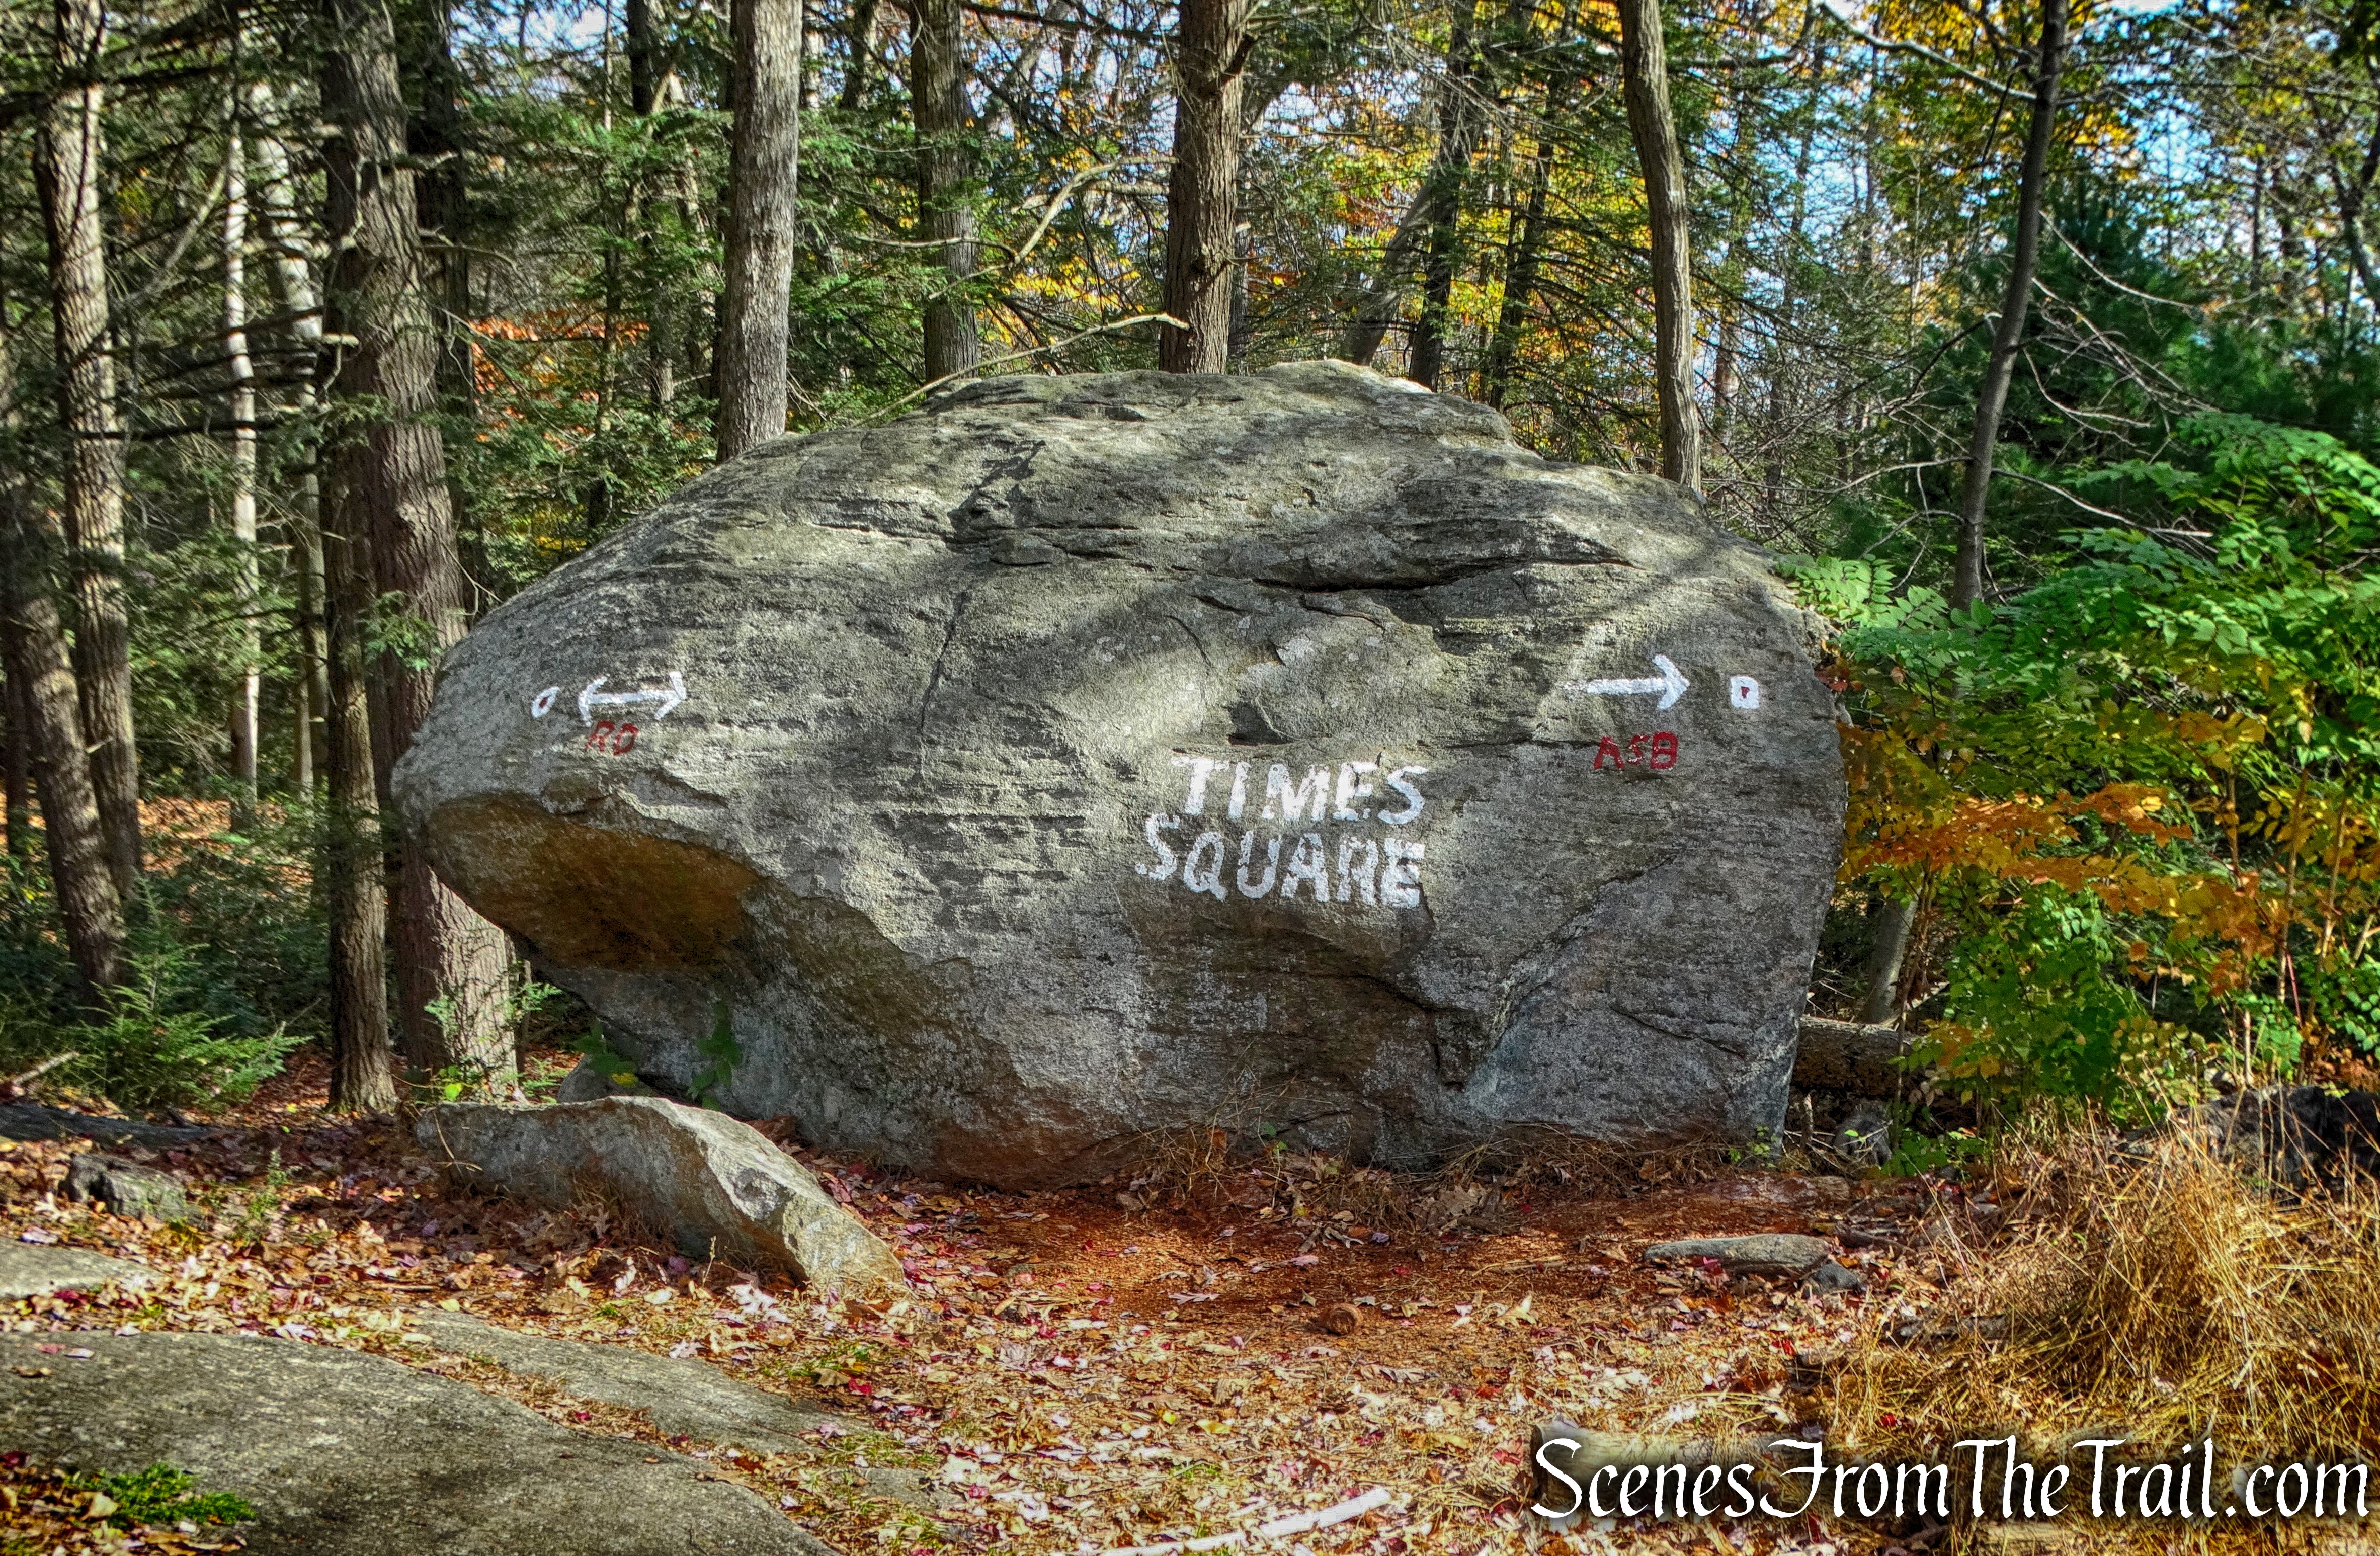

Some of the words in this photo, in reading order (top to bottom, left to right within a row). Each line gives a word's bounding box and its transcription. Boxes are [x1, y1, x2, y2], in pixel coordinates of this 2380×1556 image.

[1593, 731, 1678, 770] ASB
[1171, 756, 1428, 824] TIMES
[1135, 812, 1425, 908] SQUARE
